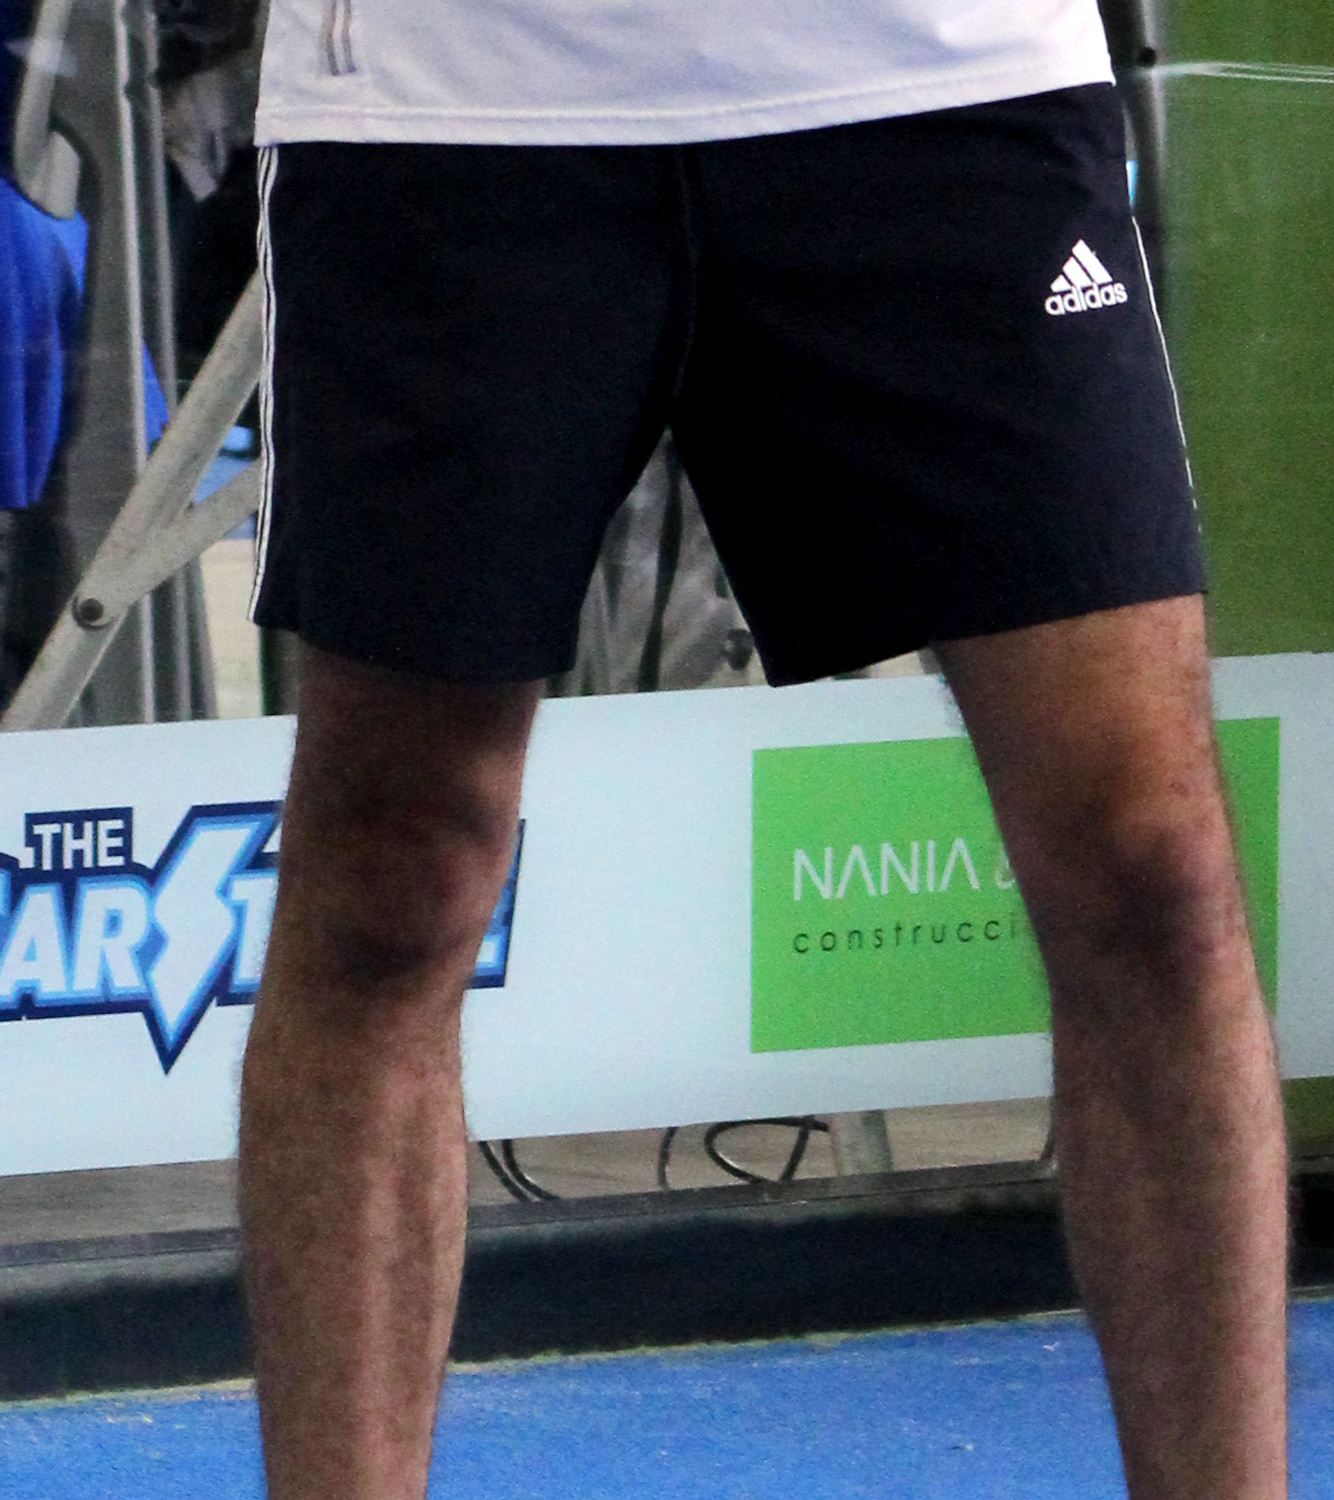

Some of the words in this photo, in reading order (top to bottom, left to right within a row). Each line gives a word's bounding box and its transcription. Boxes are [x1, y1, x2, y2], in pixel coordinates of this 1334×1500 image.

[1044, 282, 1129, 316] adidas
[31, 819, 128, 870] THE
[794, 837, 980, 902] NANIA
